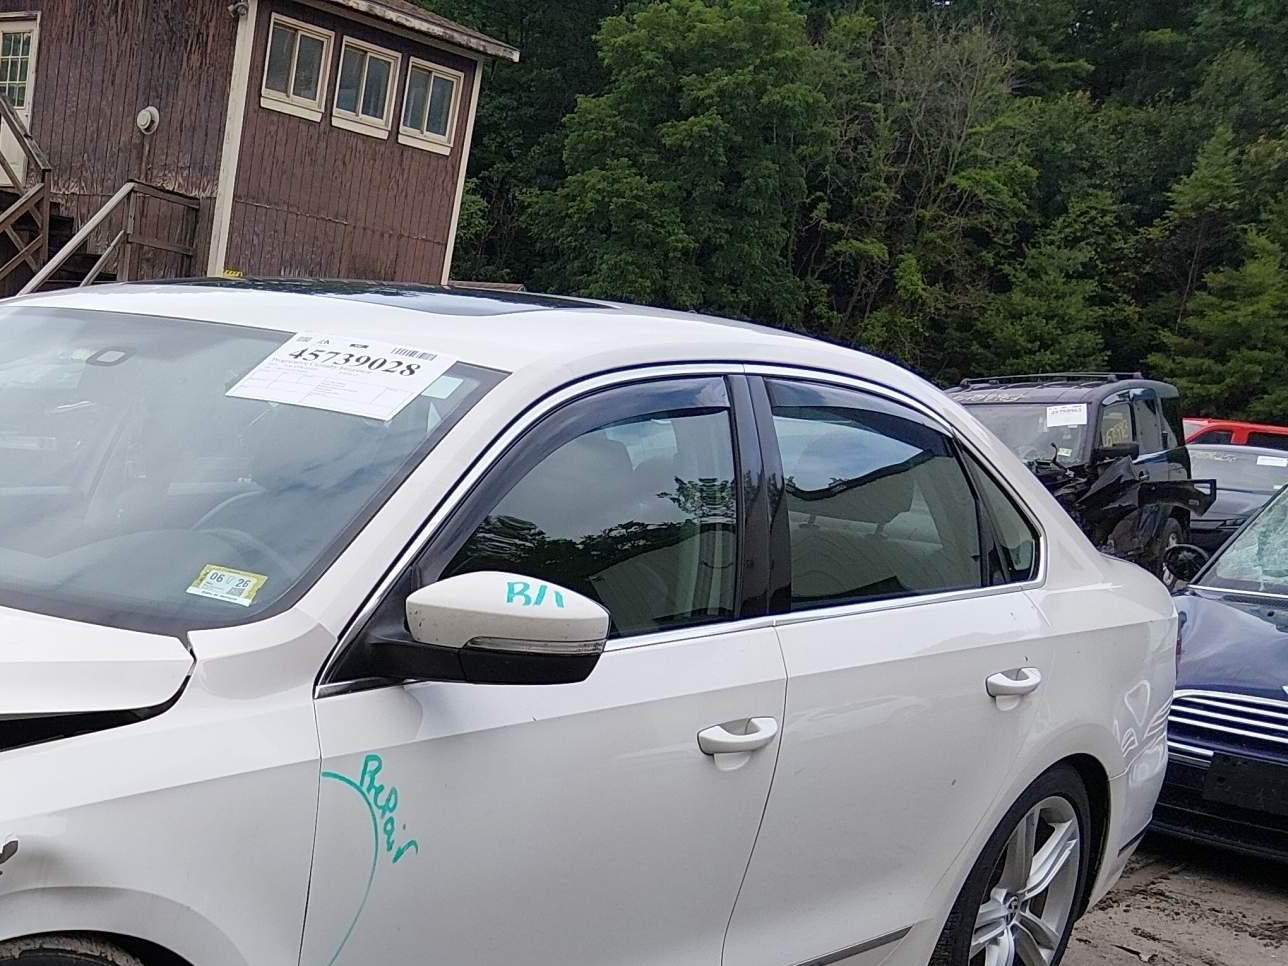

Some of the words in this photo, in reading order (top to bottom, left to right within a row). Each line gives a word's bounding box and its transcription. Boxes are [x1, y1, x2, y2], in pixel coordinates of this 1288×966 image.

[288, 346, 422, 377] 45739028
[209, 571, 225, 583] 06
[235, 578, 252, 588] 26
